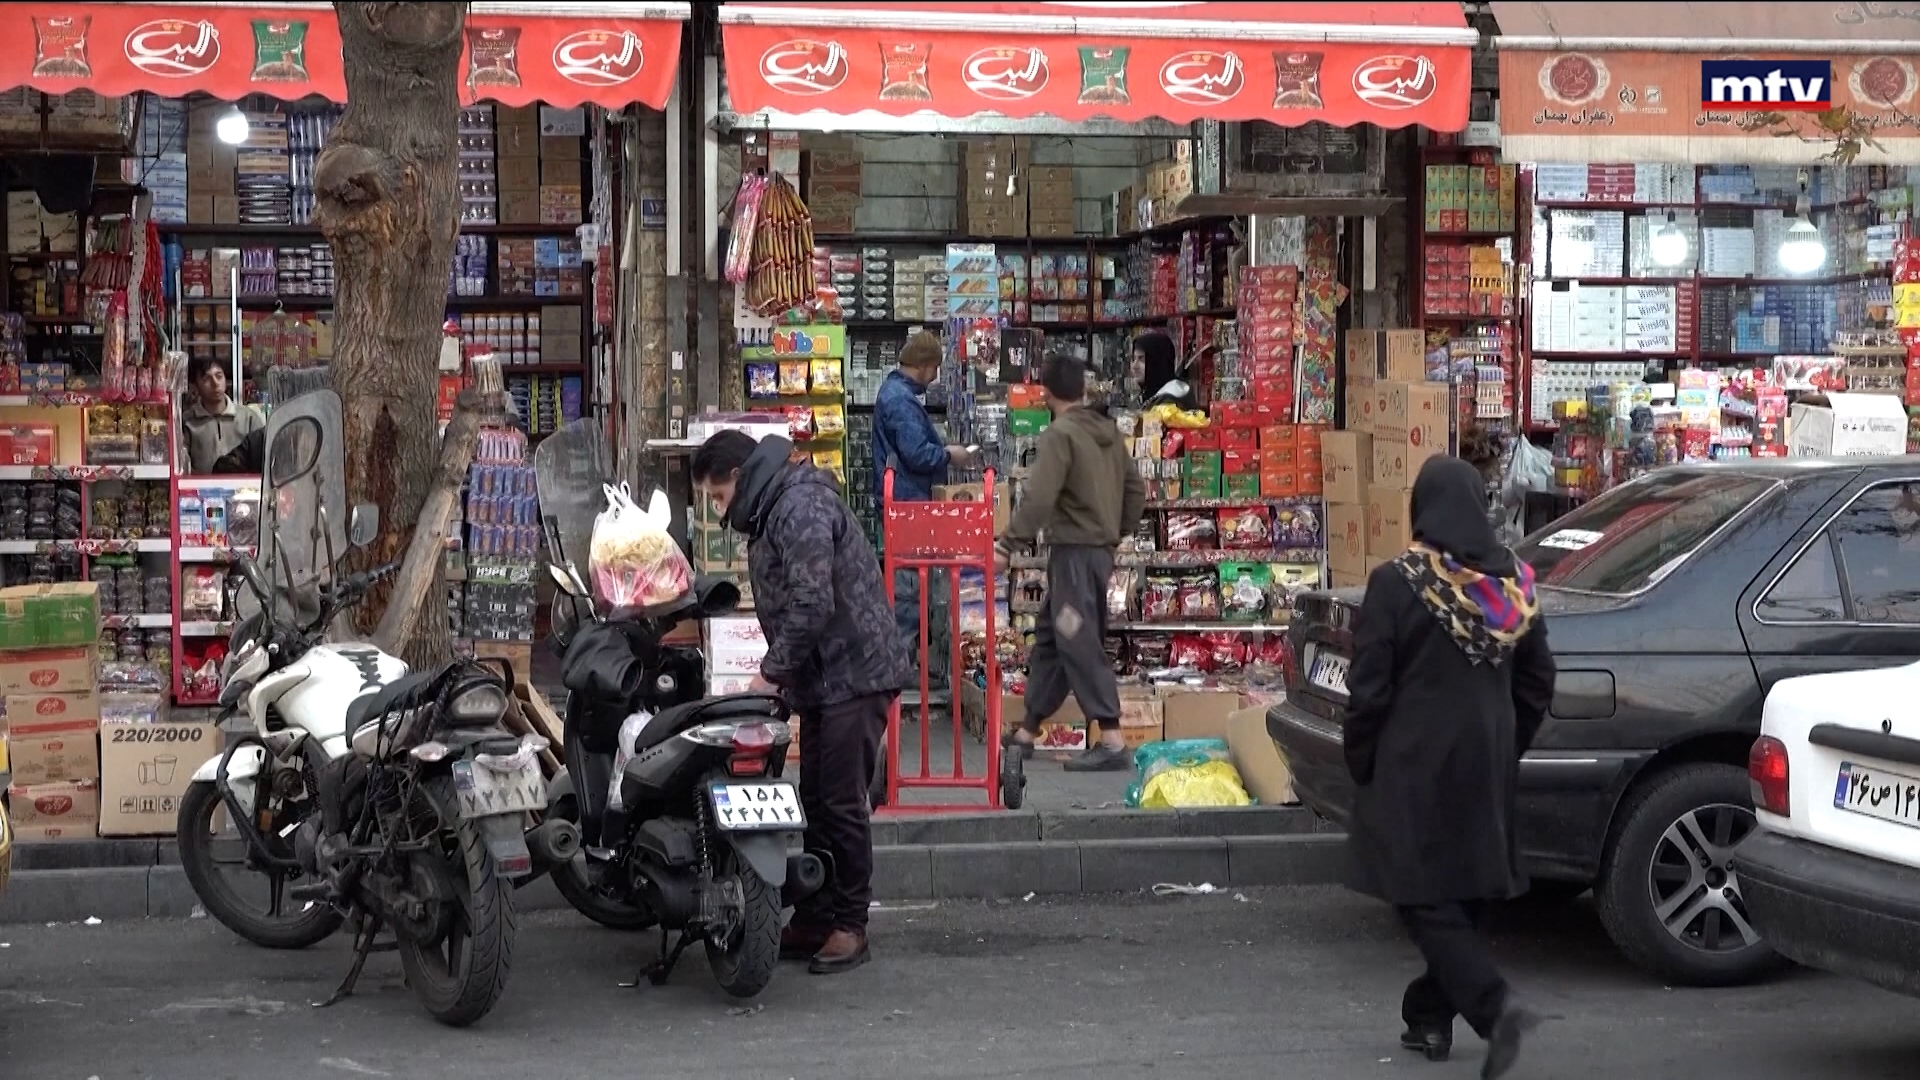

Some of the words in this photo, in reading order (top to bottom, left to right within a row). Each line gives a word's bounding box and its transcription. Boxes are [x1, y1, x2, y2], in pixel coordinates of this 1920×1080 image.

[131, 19, 212, 63] الیت
[559, 30, 636, 72] الیت
[766, 41, 843, 82] الیت
[968, 48, 1044, 87] الیت
[1165, 51, 1239, 92] الیت
[1358, 55, 1432, 95] الیت
[111, 727, 203, 744] 220/2000
[721, 806, 795, 822] ۲۴۷۱۴
[741, 787, 784, 801] ۱۵۸
